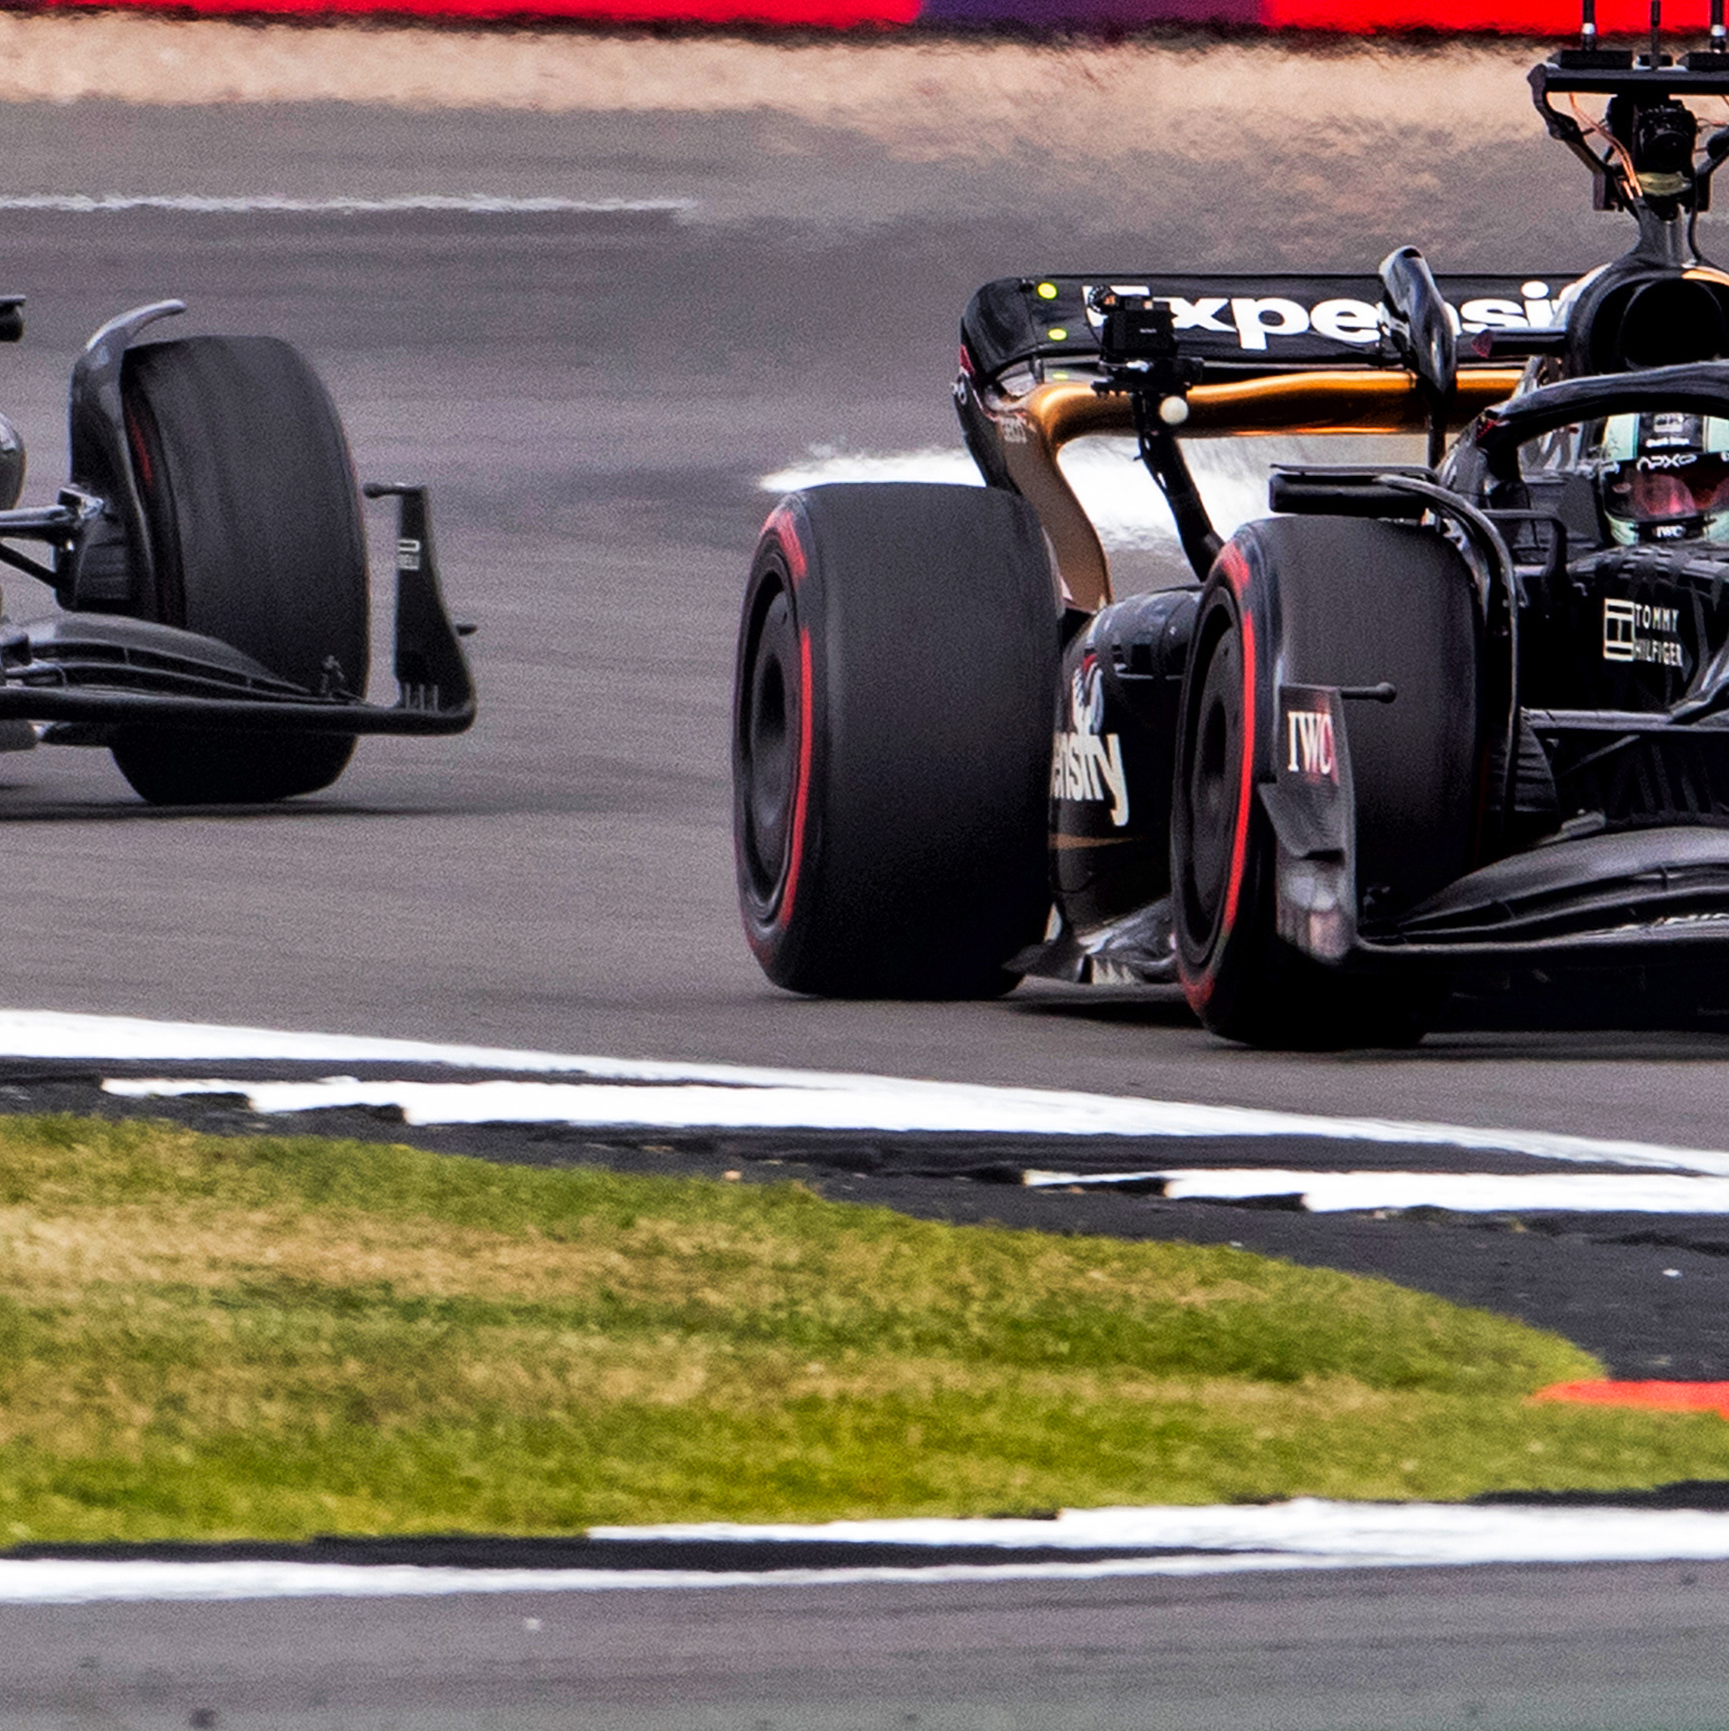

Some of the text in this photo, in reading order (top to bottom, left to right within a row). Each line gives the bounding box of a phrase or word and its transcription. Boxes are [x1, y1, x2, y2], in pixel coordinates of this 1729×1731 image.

[1635, 604, 1679, 632] TOMMY
[1635, 638, 1683, 667] HILFIGER
[1287, 711, 1336, 774] IWC
